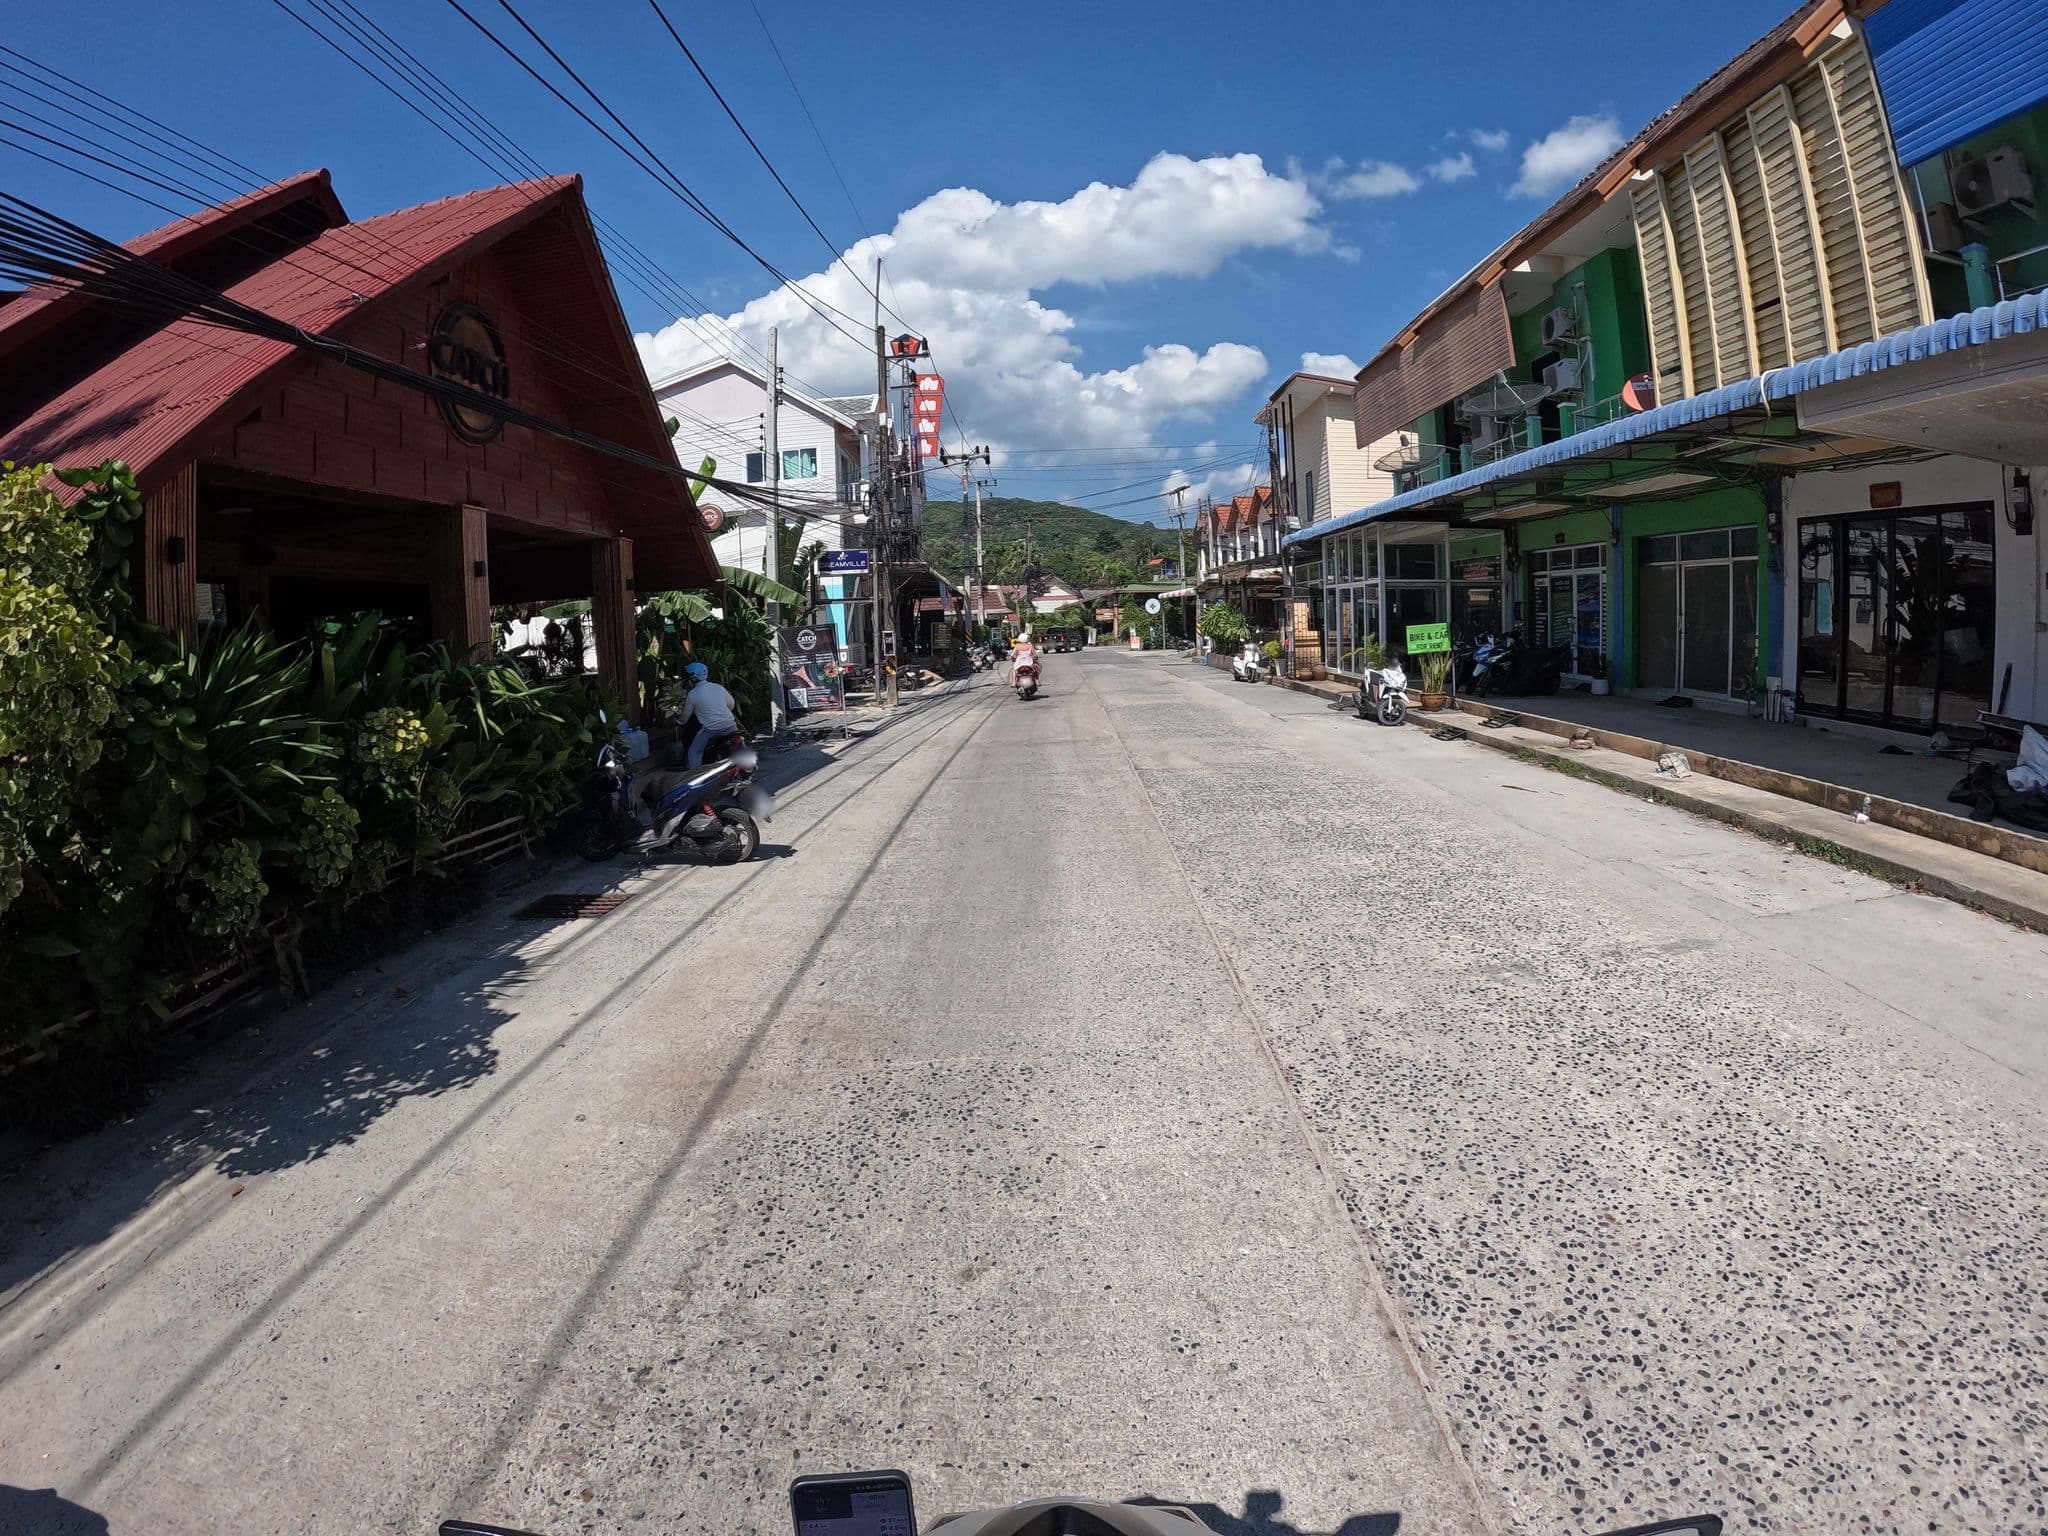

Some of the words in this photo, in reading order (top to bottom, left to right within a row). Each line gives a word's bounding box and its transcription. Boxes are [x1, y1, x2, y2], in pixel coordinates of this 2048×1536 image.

[1409, 632, 1425, 642] BIKE
[1427, 632, 1433, 640] &
[1434, 630, 1449, 640] CAR
